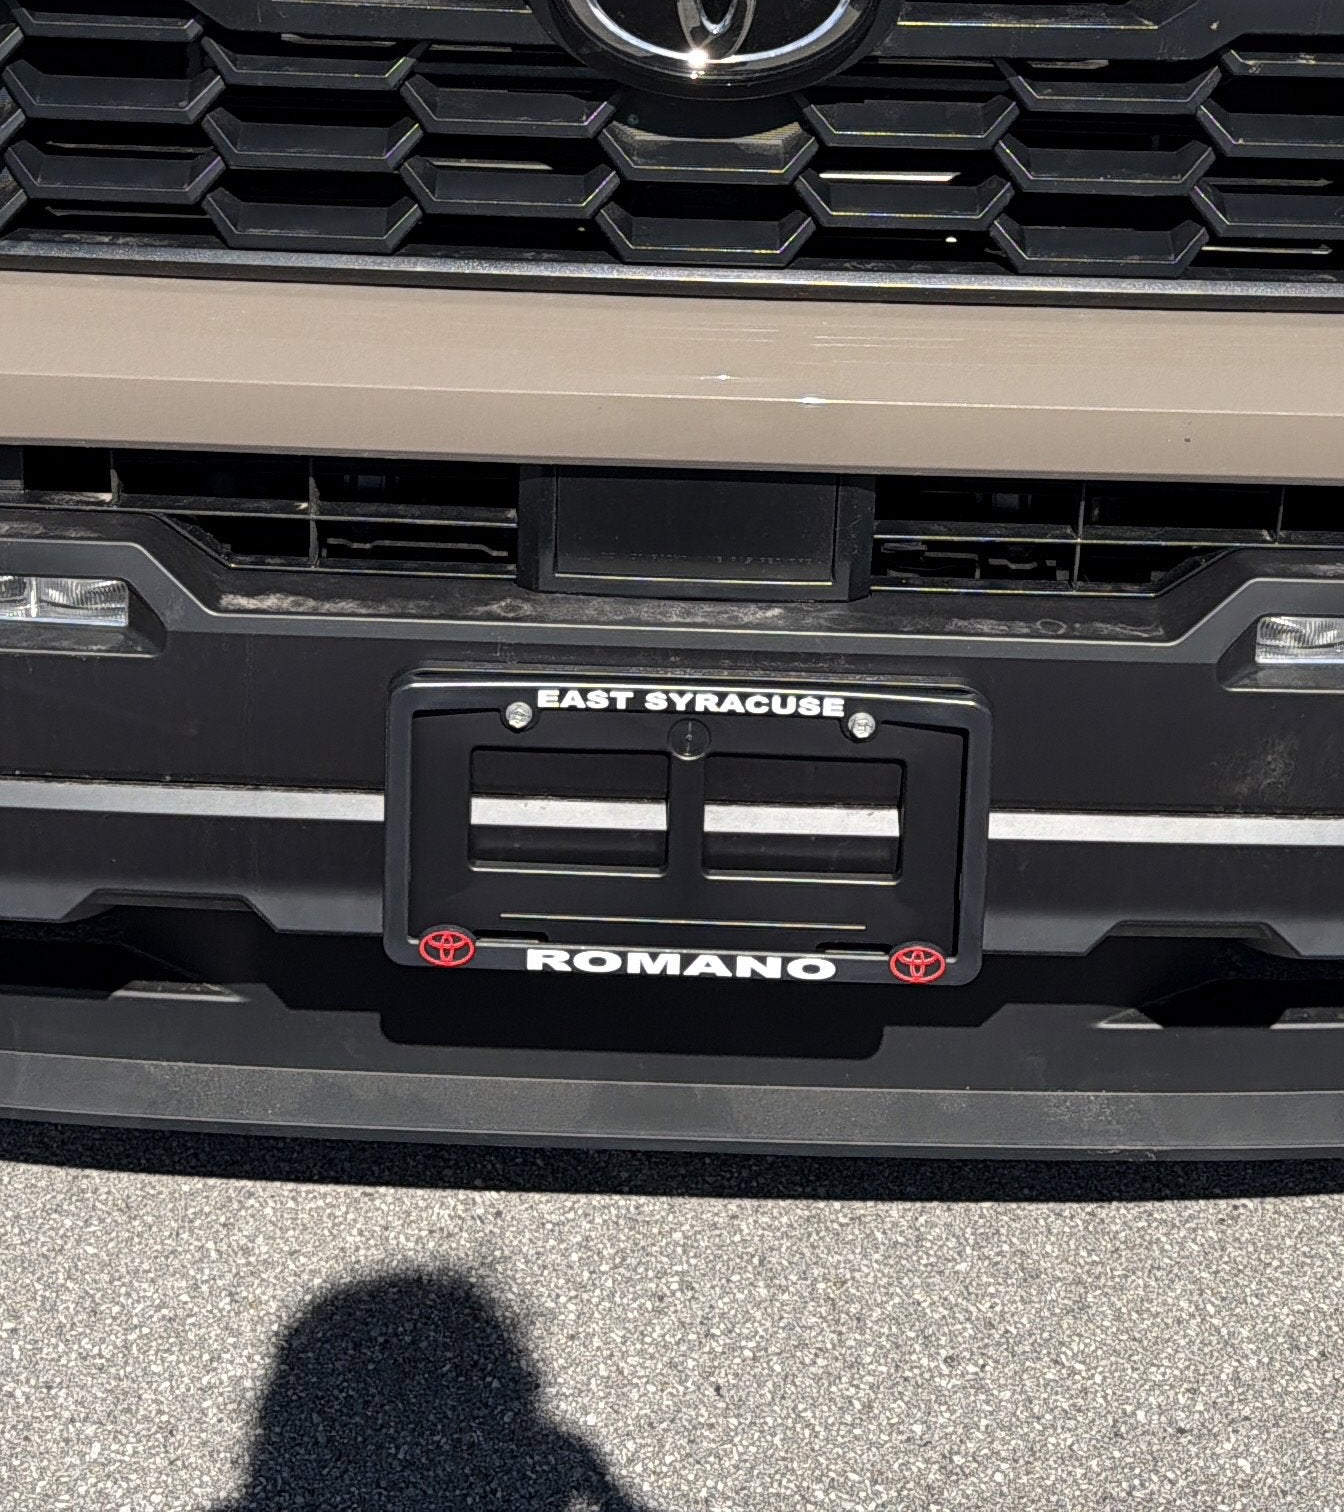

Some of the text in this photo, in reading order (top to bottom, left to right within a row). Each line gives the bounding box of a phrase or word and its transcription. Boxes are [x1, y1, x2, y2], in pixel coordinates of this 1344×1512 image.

[537, 689, 845, 718] EAST SYRACUSE
[526, 948, 836, 980] ROMANO
